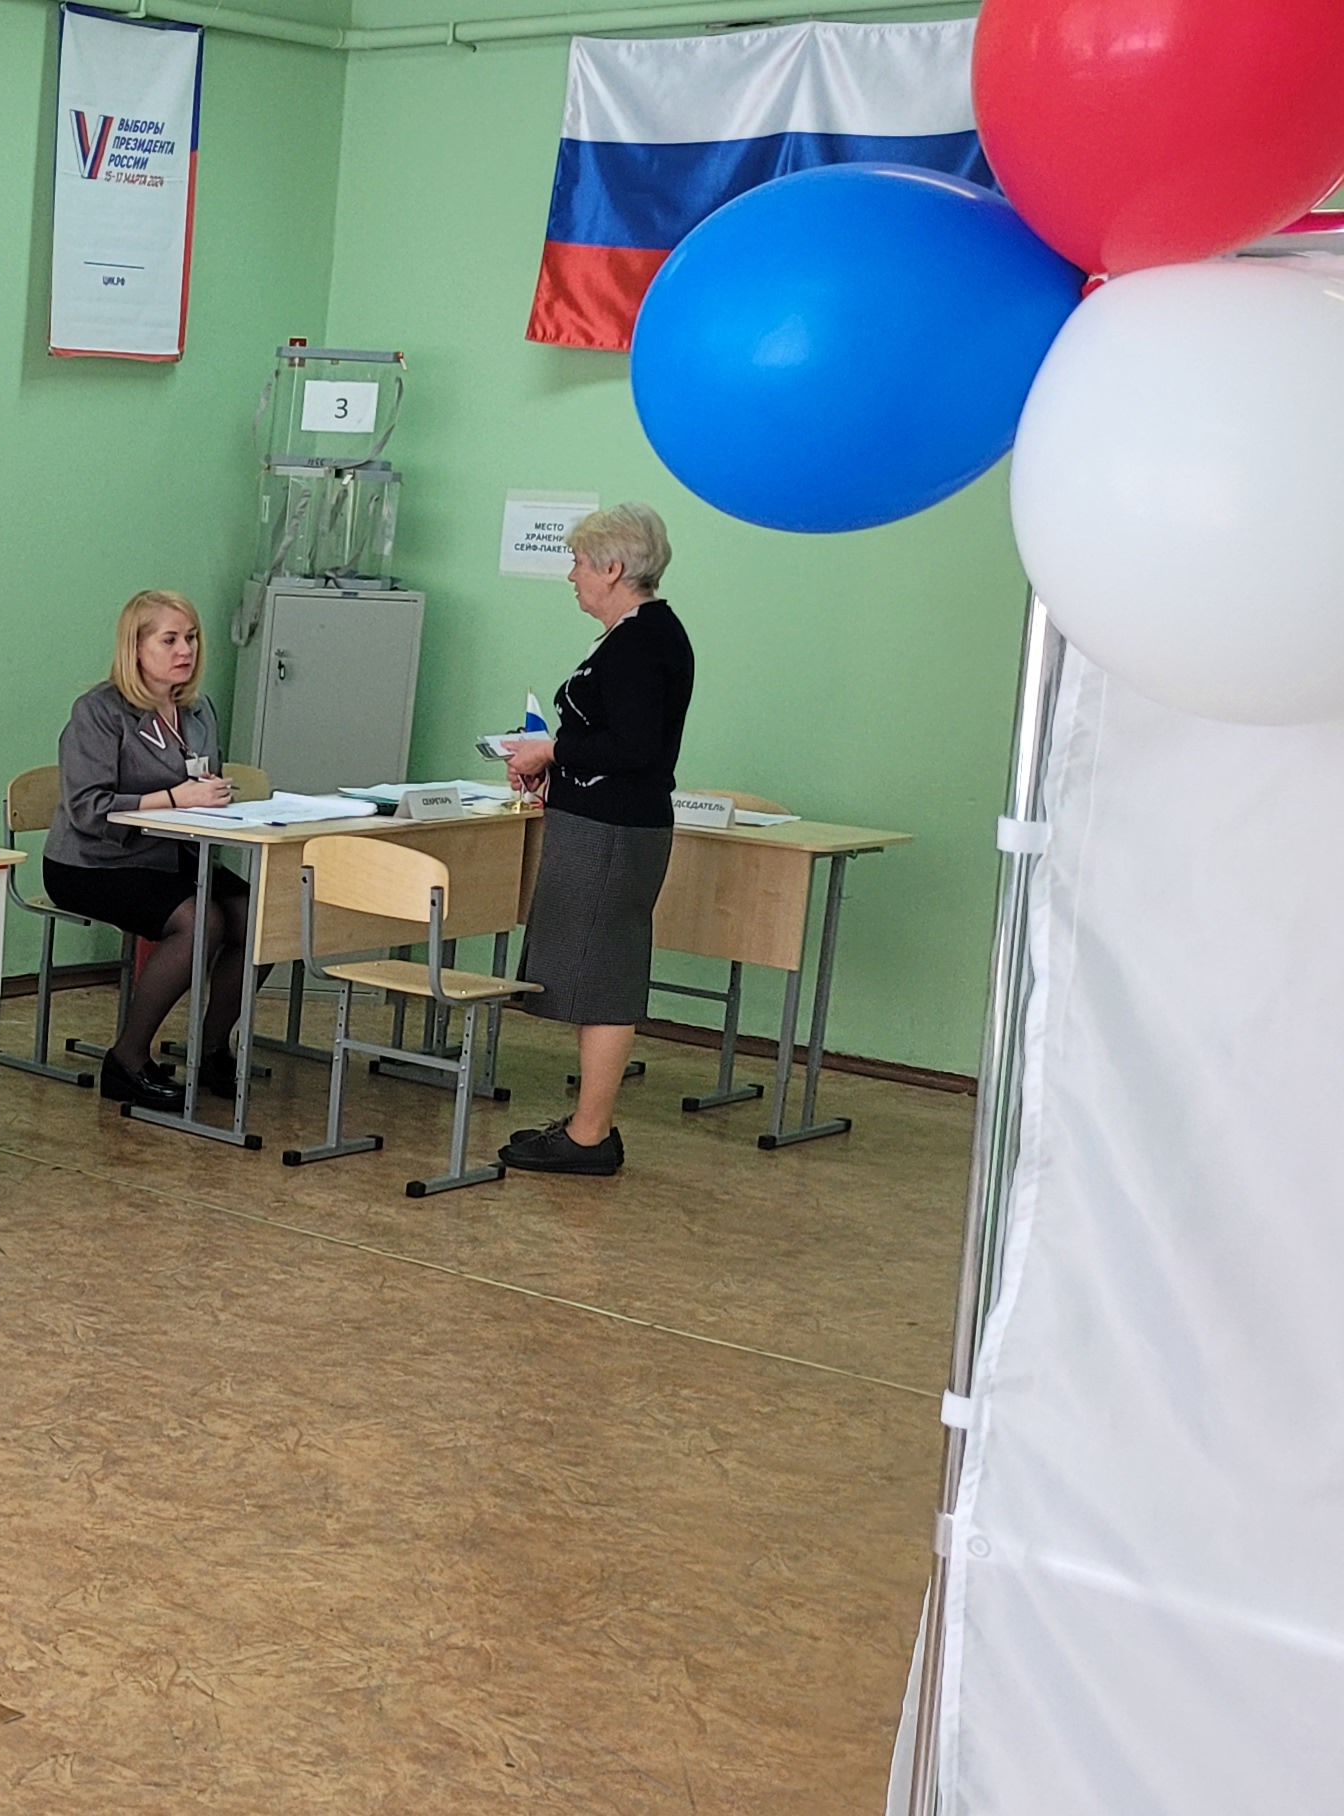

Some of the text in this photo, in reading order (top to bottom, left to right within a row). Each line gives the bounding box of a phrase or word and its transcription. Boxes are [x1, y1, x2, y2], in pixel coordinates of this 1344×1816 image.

[117, 118, 165, 135] ВЫБОРЫ
[112, 136, 175, 155] ПРЕЗИДЕНТА
[108, 153, 149, 170] РОССИИ
[123, 172, 147, 186] МАРТА
[147, 176, 164, 187] 2024
[333, 397, 349, 419] 3
[534, 522, 564, 532] МЕСТО
[525, 533, 564, 542] ХРАНЕНИ
[514, 543, 574, 554] СЕЙФ-ПАКЕТО
[673, 799, 725, 812] ДСЕДАТЕЛЬ
